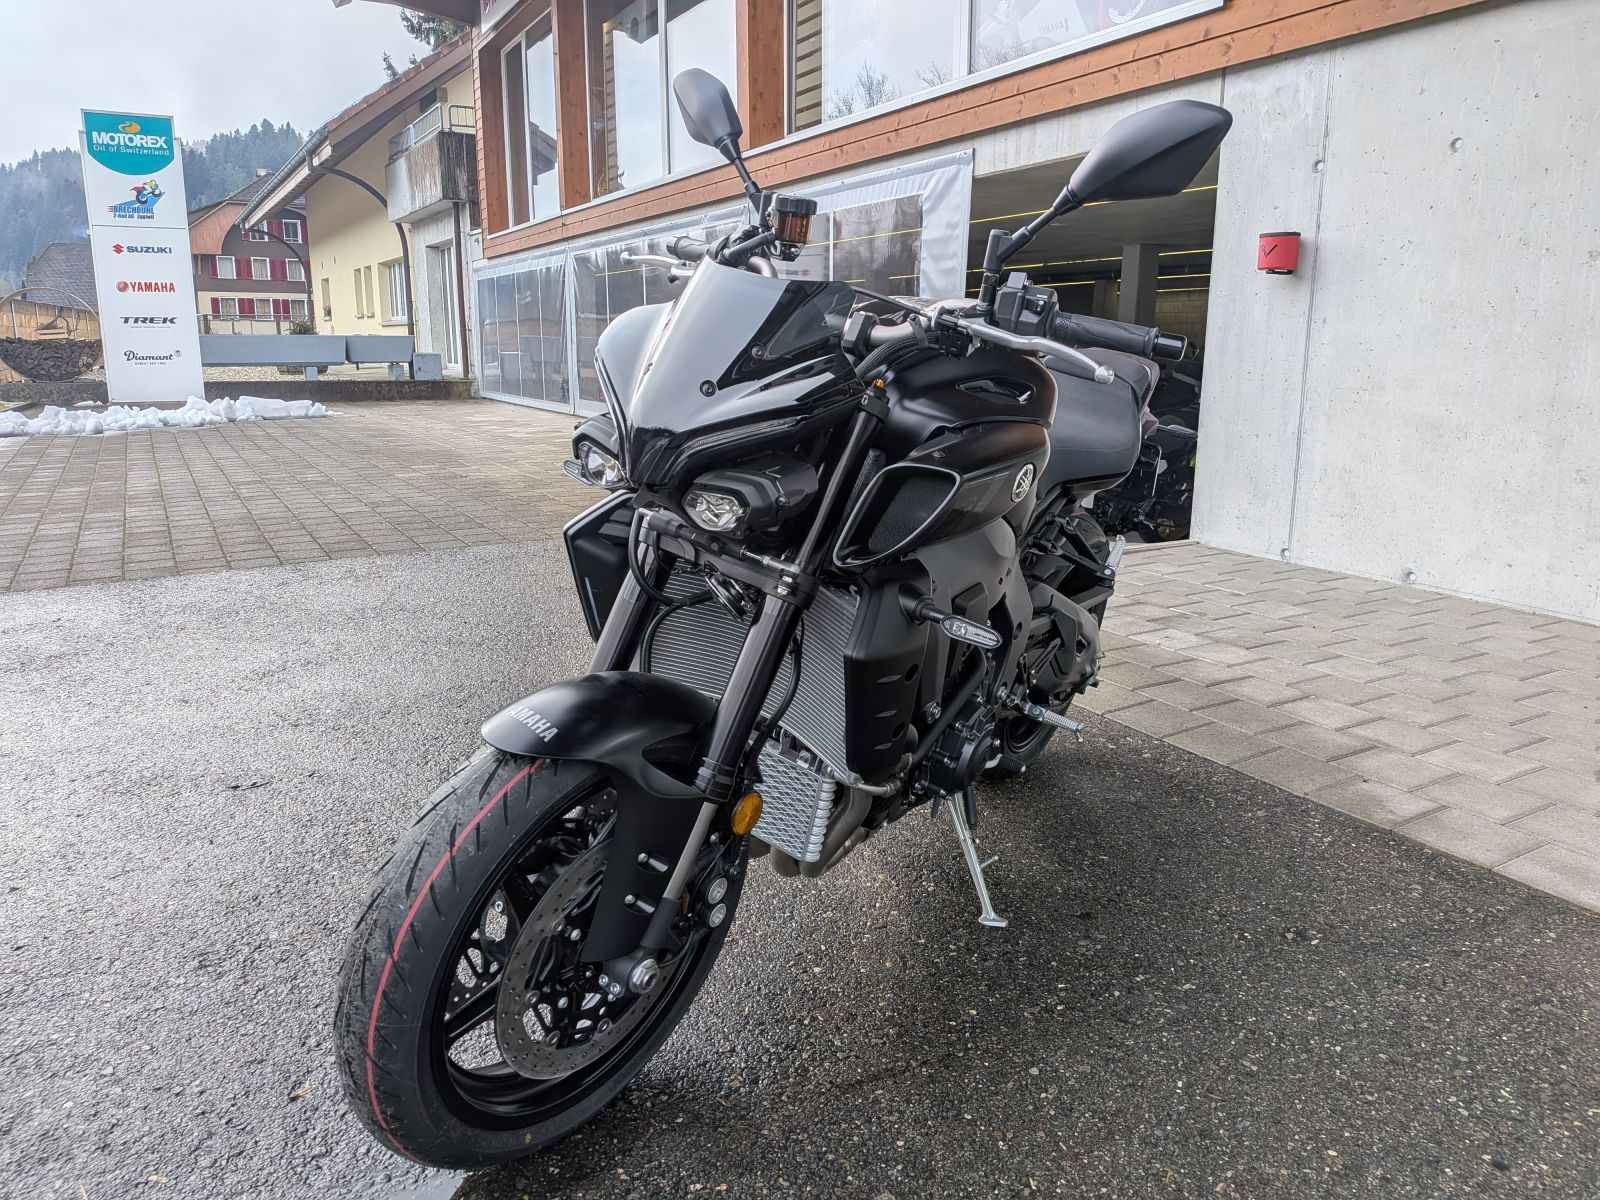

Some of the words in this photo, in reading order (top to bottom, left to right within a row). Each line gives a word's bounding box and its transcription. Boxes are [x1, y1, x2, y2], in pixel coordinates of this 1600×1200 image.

[92, 131, 168, 148] MOTOREX
[120, 146, 170, 156] Switzerland
[126, 245, 172, 254] SUZUKI
[129, 281, 176, 293] YAMAHA
[119, 316, 178, 324] TREK
[123, 349, 174, 361] Diamant
[503, 705, 559, 743] YAMAHA
